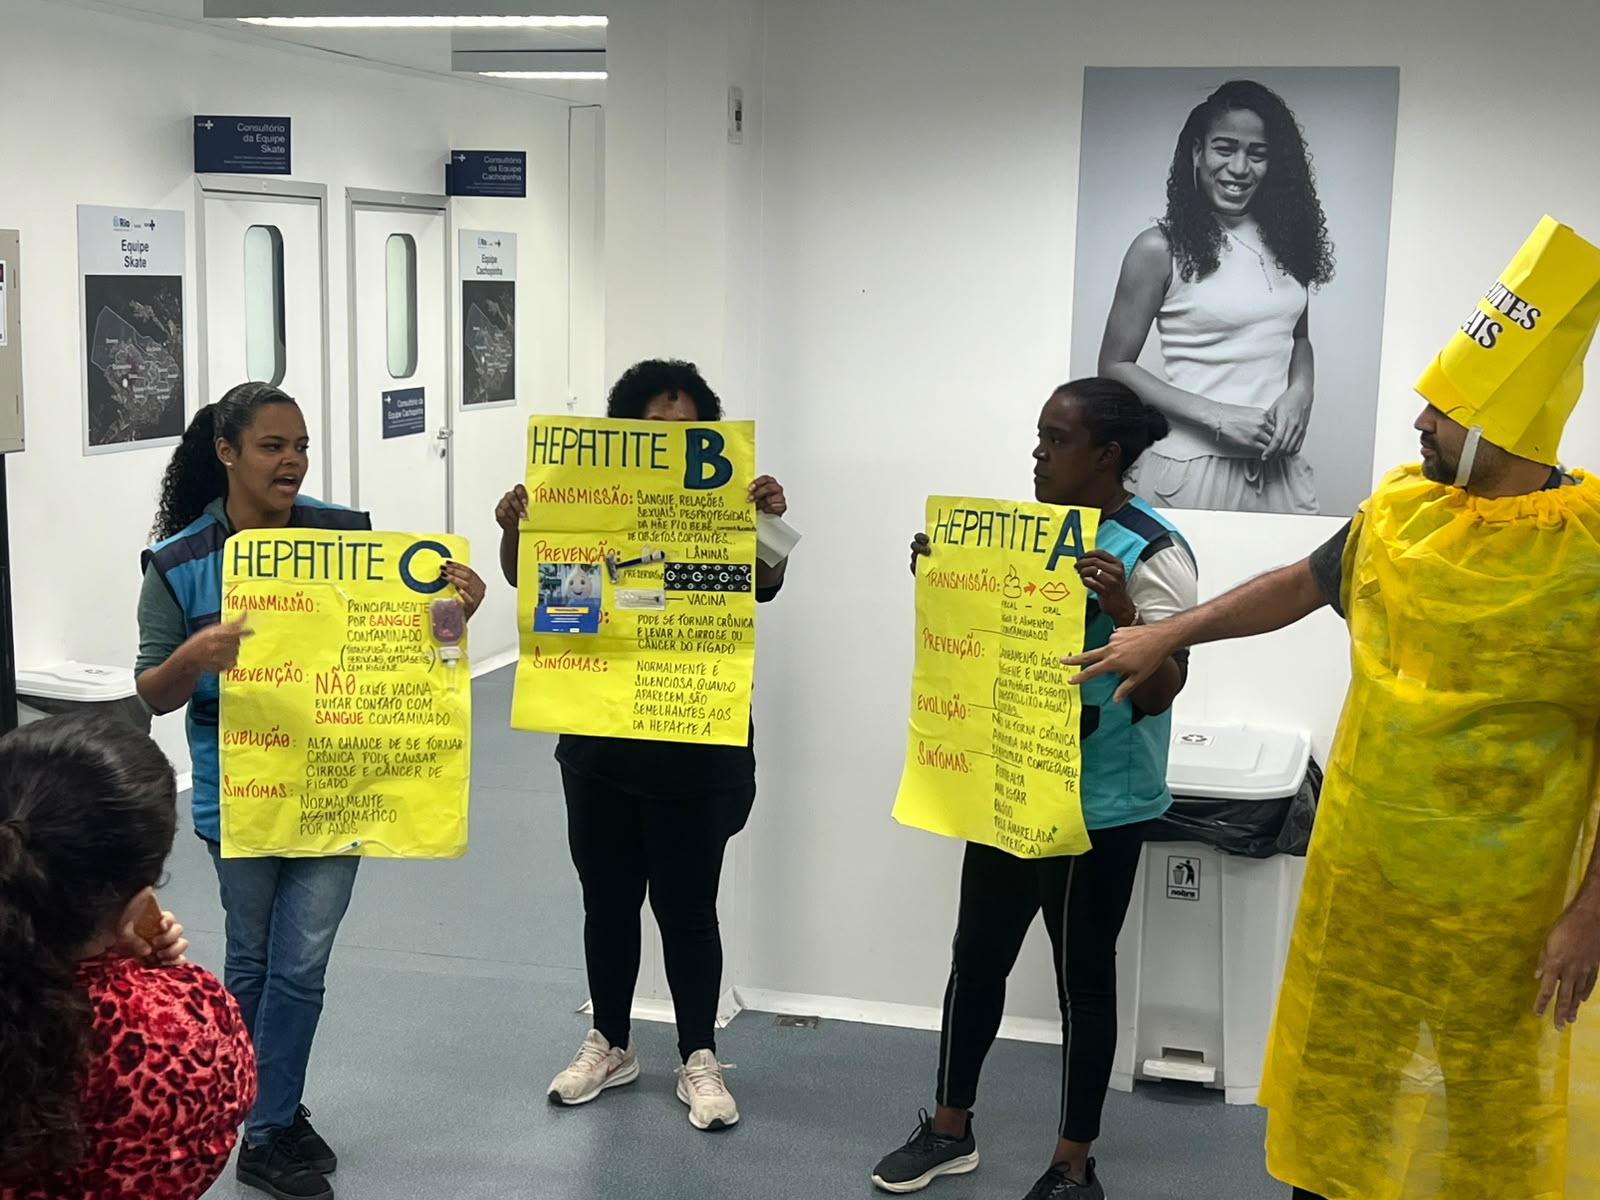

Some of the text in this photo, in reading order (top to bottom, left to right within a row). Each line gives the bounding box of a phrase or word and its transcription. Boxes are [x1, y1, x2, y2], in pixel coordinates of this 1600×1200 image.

[237, 123, 286, 133] Consultório
[243, 134, 286, 144] da Equipe
[261, 144, 286, 153] Skate
[121, 239, 149, 254] Equipe
[124, 255, 147, 268] Skate
[532, 425, 733, 490] HEPATITE B
[532, 481, 633, 505] TRANSMISSÃO:
[933, 507, 1086, 571] HEPATITE A
[686, 545, 728, 560] LÂMINAS
[233, 535, 452, 594] HEPATITE C
[926, 567, 1001, 593] TRANSMISSÃO:
[347, 599, 430, 613] PRINCIPALMENTE
[687, 594, 726, 606] VACINA
[347, 614, 421, 627] POR SANGUE
[638, 615, 659, 625] PODE
[663, 615, 675, 625] SE
[679, 613, 715, 627] TORNAR
[347, 628, 422, 642] CONTAMINADO
[677, 629, 685, 638] A
[732, 630, 743, 641] OU
[680, 641, 693, 651] DO
[922, 627, 985, 660] PREVENÇÃO:
[533, 645, 608, 672] SINTOMAS:
[636, 659, 721, 677] NORMALMENTE É
[316, 665, 356, 695] NÃO
[391, 682, 432, 696] VACINA
[696, 678, 736, 693] QUANDO
[315, 697, 432, 711] EVITAR CONTATO COM
[688, 690, 708, 705] SÃO
[315, 710, 450, 726] SANGUE CONTAMINADO
[633, 702, 731, 721] SEMELHANTES AOS
[633, 720, 711, 736] DA HEPATITE A
[307, 735, 464, 750] ALTA CHANCE DE SE TORNAR
[1039, 725, 1076, 748] CRÔNICA
[362, 751, 390, 764] PODE
[394, 752, 437, 764] CAUSAR
[1036, 743, 1071, 763] PESSOAS
[306, 764, 356, 777] CIRROSE
[362, 766, 369, 776] E
[428, 765, 444, 778] DE
[300, 793, 384, 810] NORMALMENTE
[300, 821, 358, 836] POR ANOS
